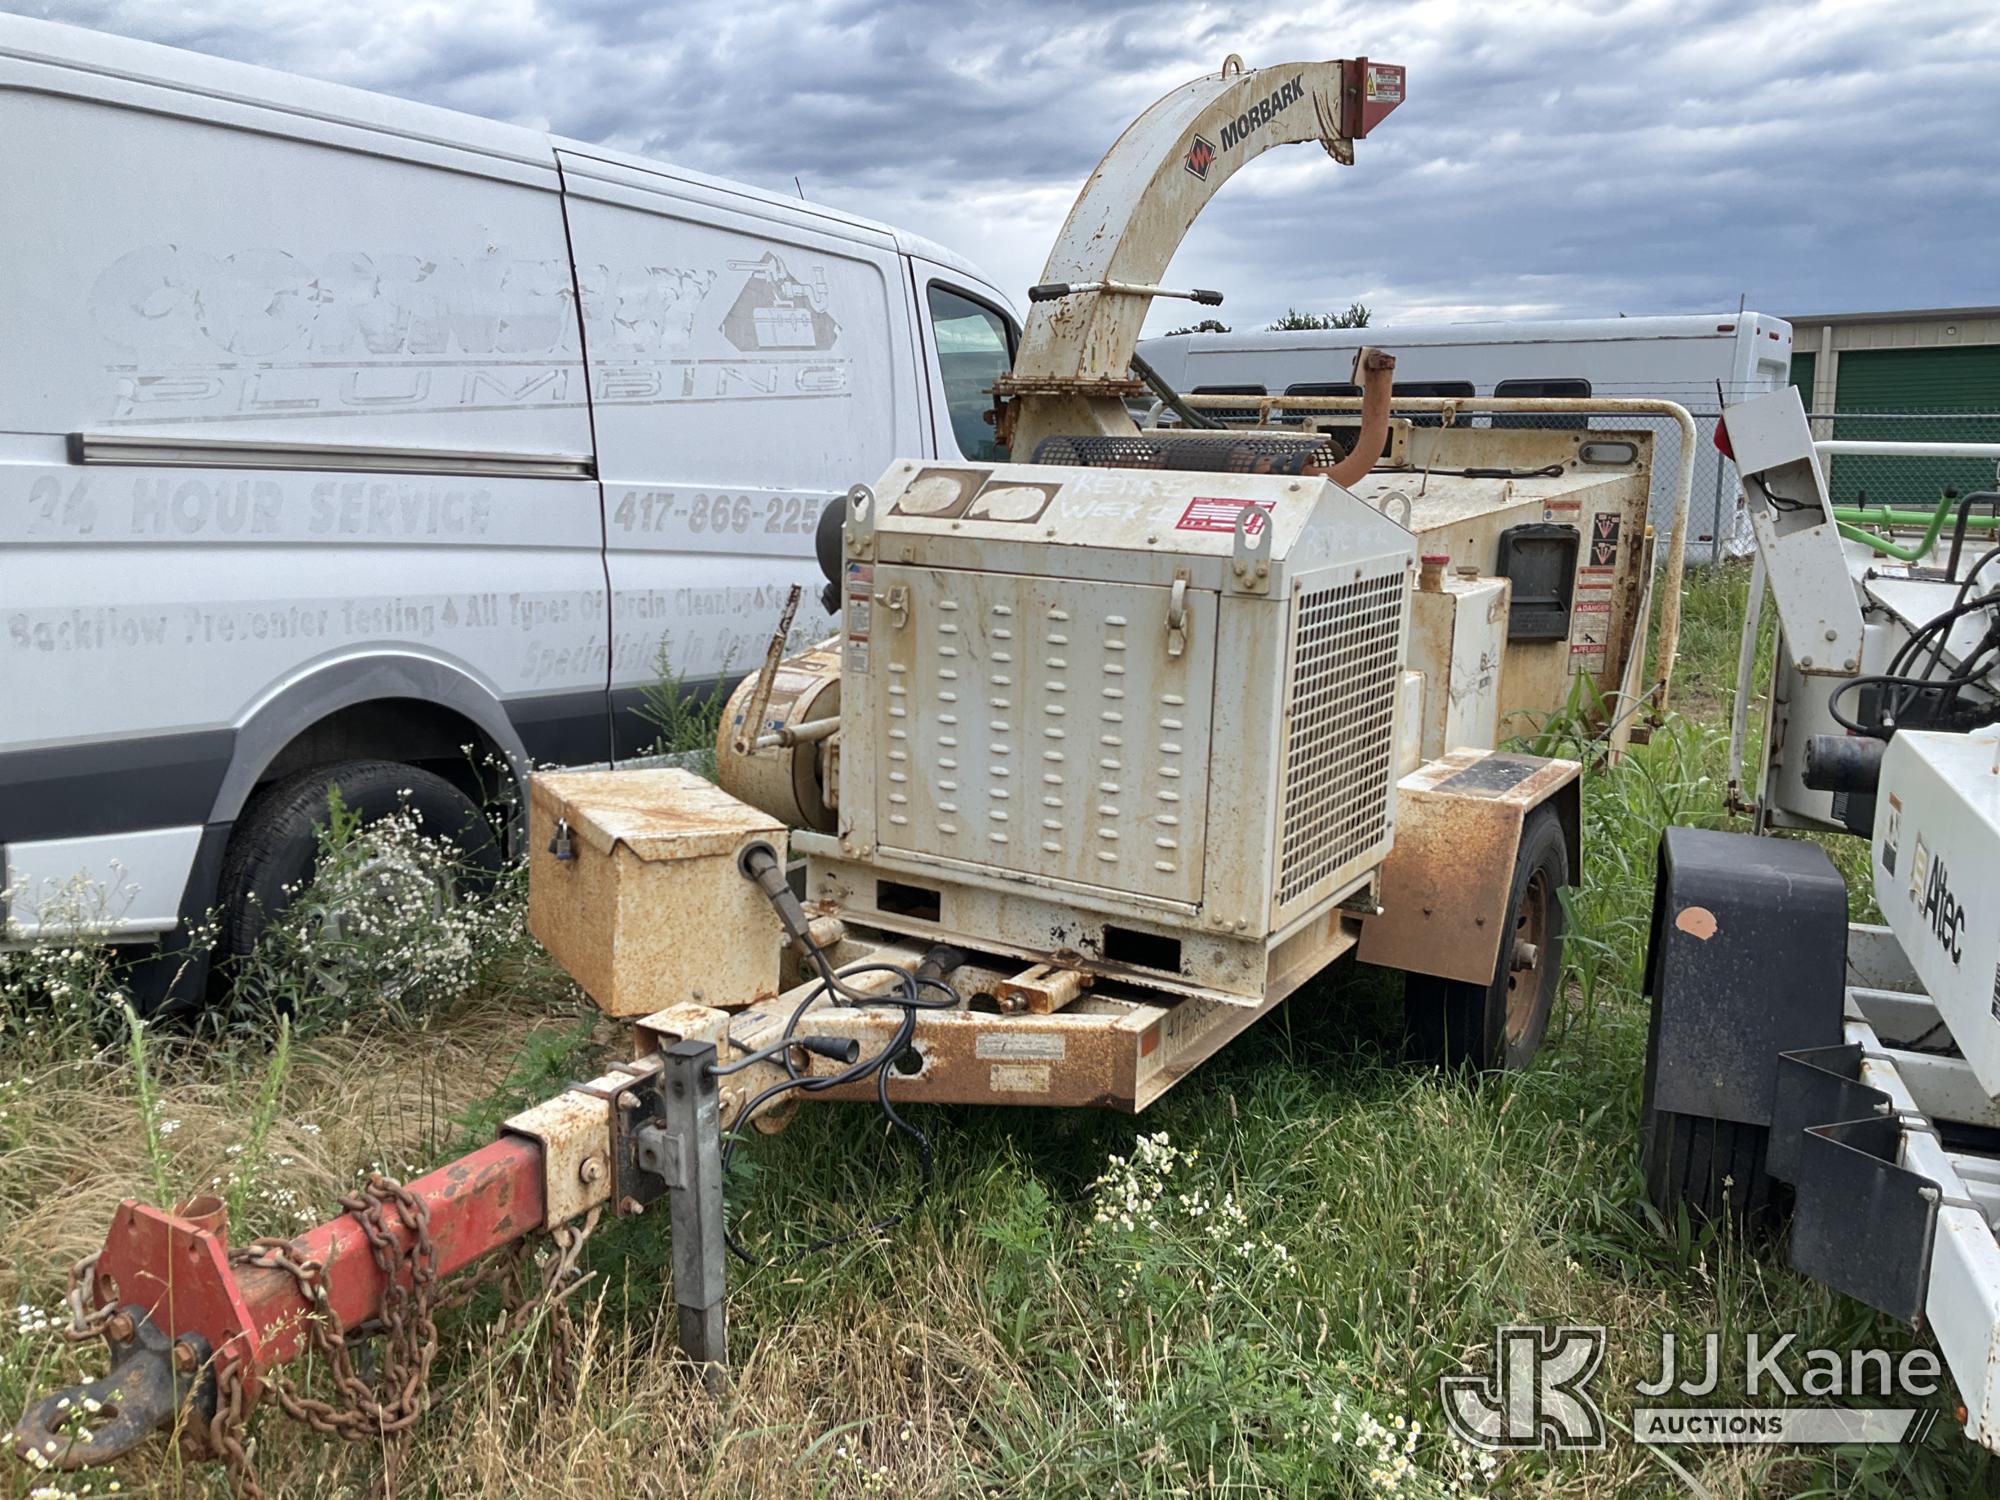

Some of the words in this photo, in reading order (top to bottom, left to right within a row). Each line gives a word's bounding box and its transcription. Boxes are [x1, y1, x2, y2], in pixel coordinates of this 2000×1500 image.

[1220, 74, 1305, 152] MORBARK
[115, 366, 848, 416] PLUMBING
[28, 475, 99, 534] 24
[130, 478, 284, 535] HOUR
[307, 481, 492, 535] SERVICE
[613, 491, 827, 534] 417-866-225
[341, 597, 435, 637] Testing
[466, 592, 499, 628] All
[509, 591, 570, 632] Types
[1924, 854, 1966, 965] Altec
